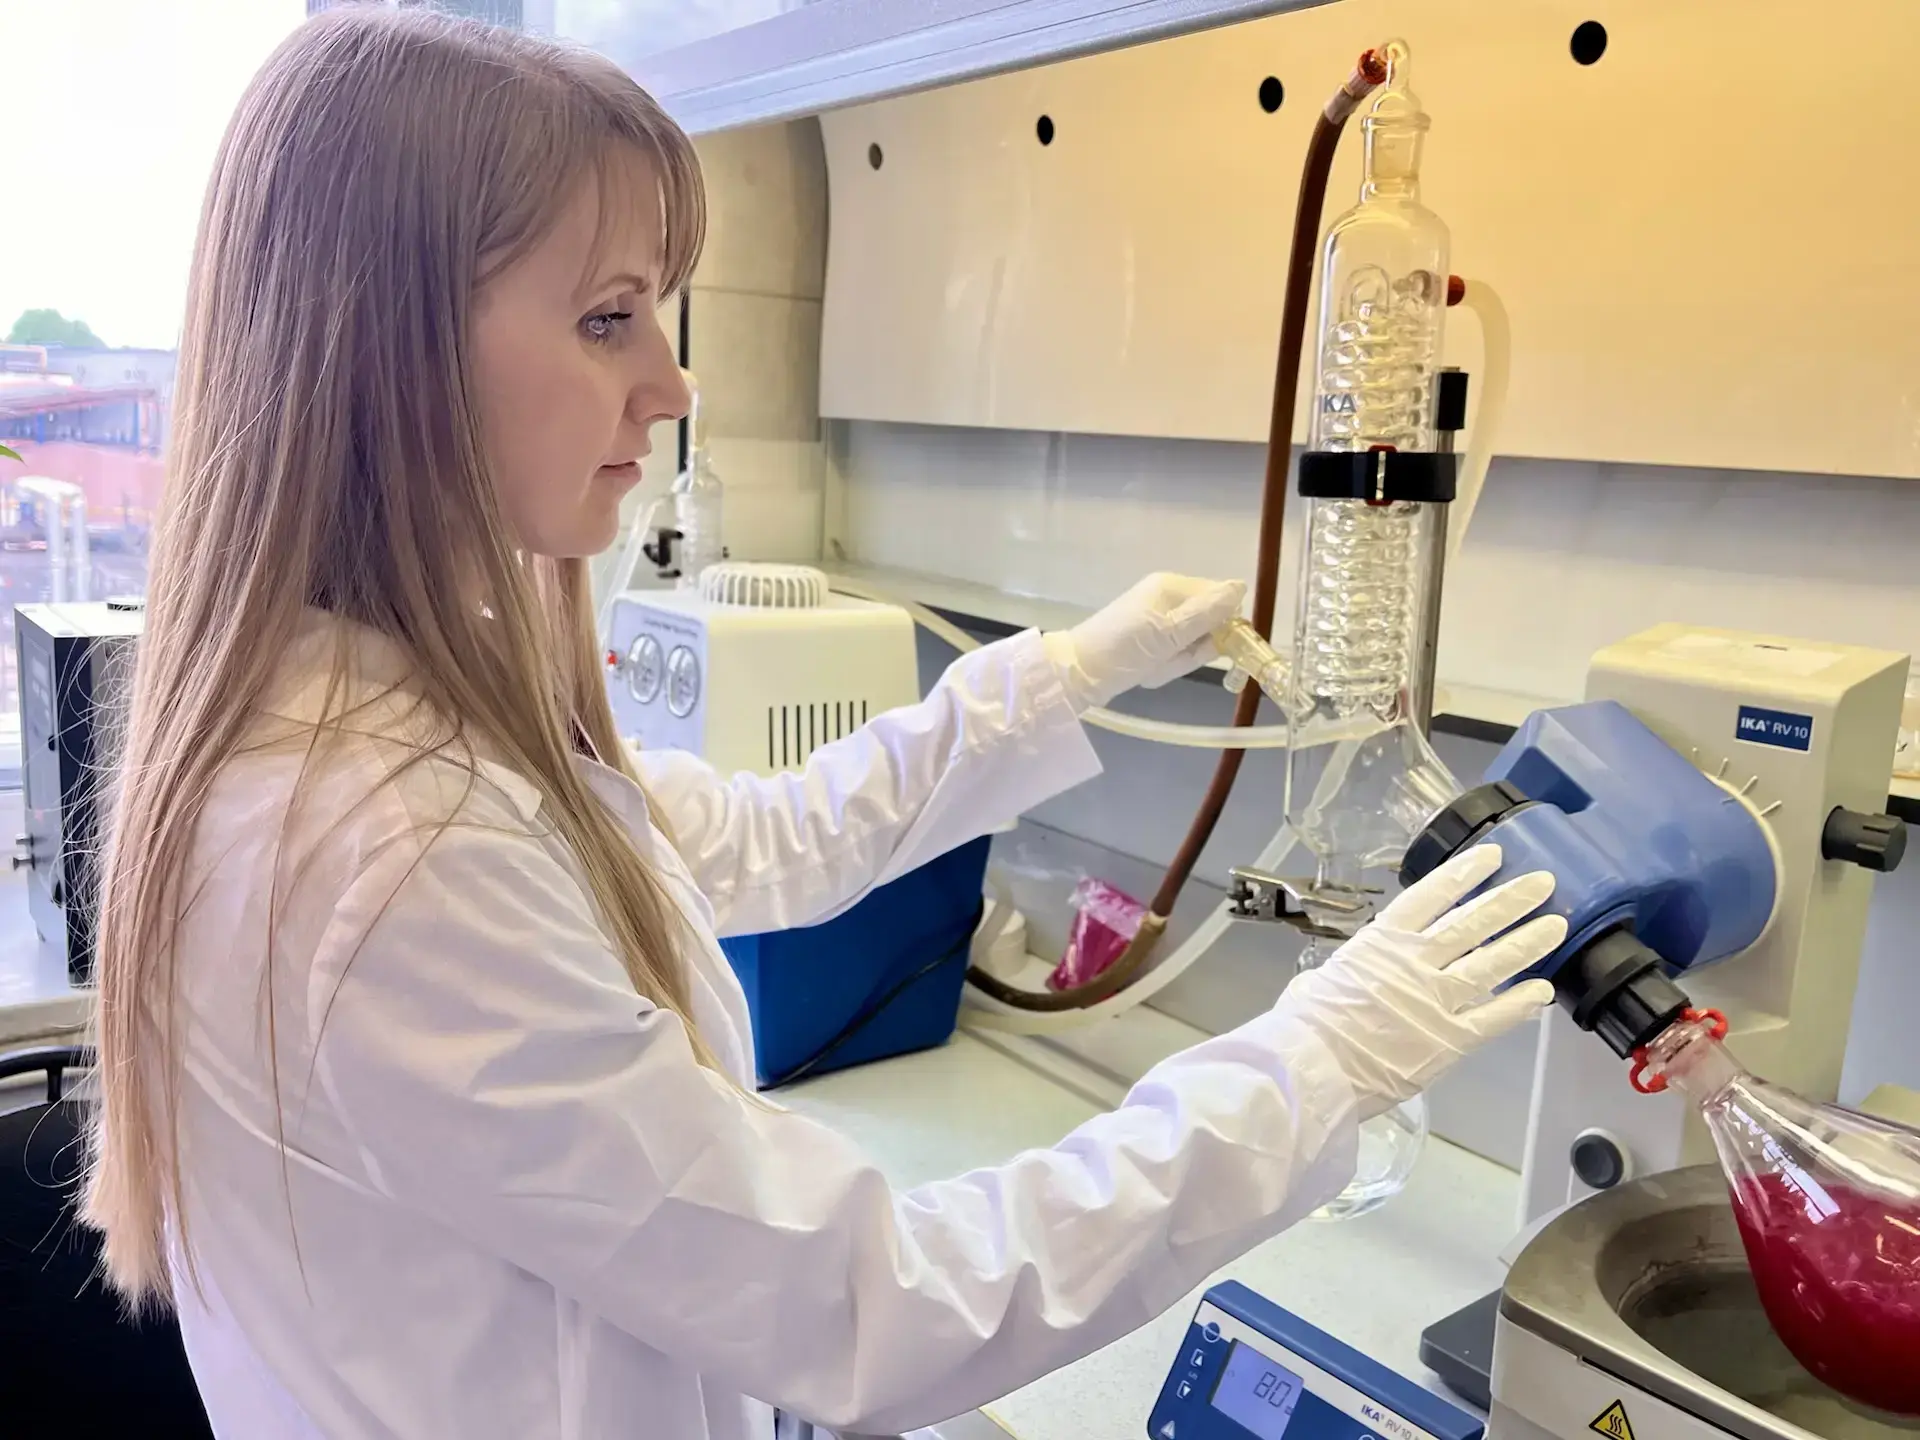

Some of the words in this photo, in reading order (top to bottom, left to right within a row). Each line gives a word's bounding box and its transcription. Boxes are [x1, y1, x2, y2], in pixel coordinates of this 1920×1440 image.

[1772, 722, 1792, 736] RV
[1794, 726, 1809, 739] 10
[1253, 1371, 1292, 1408] 80
[1385, 1418, 1402, 1433] RV
